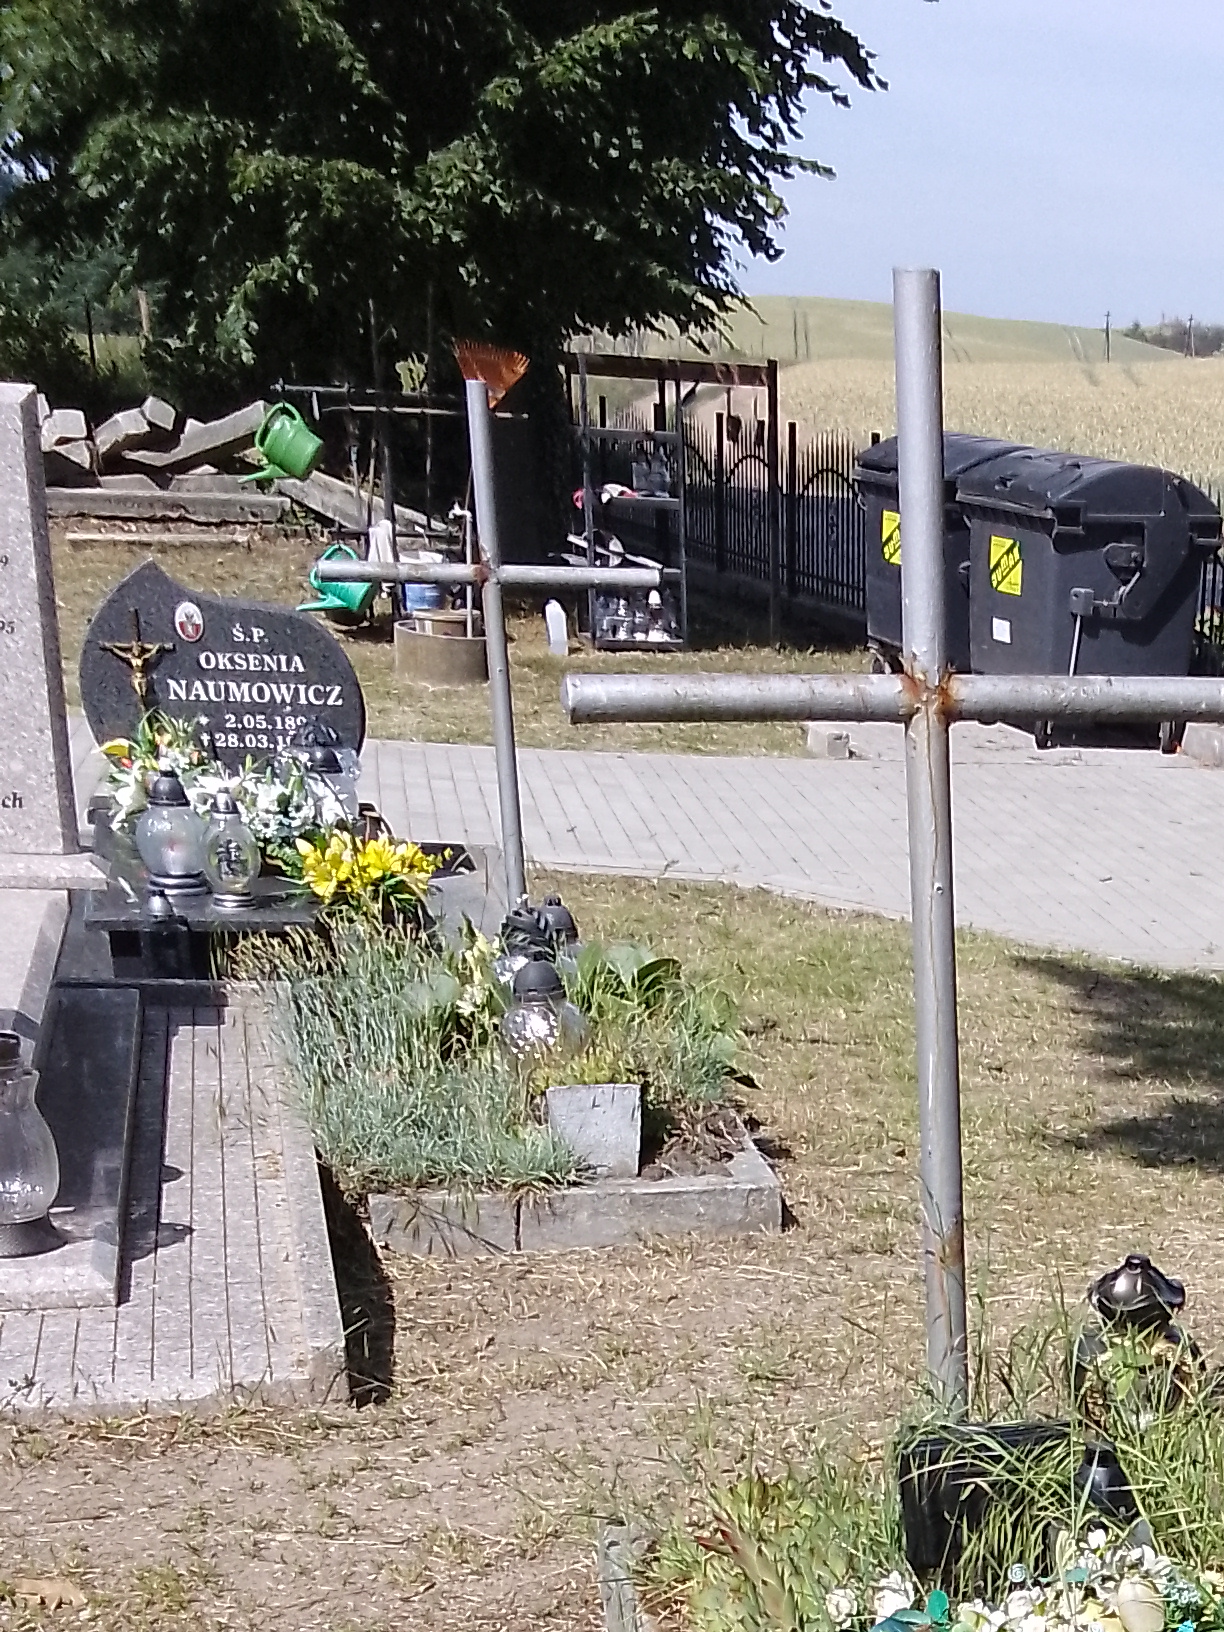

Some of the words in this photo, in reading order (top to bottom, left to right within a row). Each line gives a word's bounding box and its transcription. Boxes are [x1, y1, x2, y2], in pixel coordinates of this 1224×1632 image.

[198, 650, 306, 673] OKSENIA
[166, 678, 344, 706] NAUMOWICZ
[223, 713, 308, 731] 2.05.189
